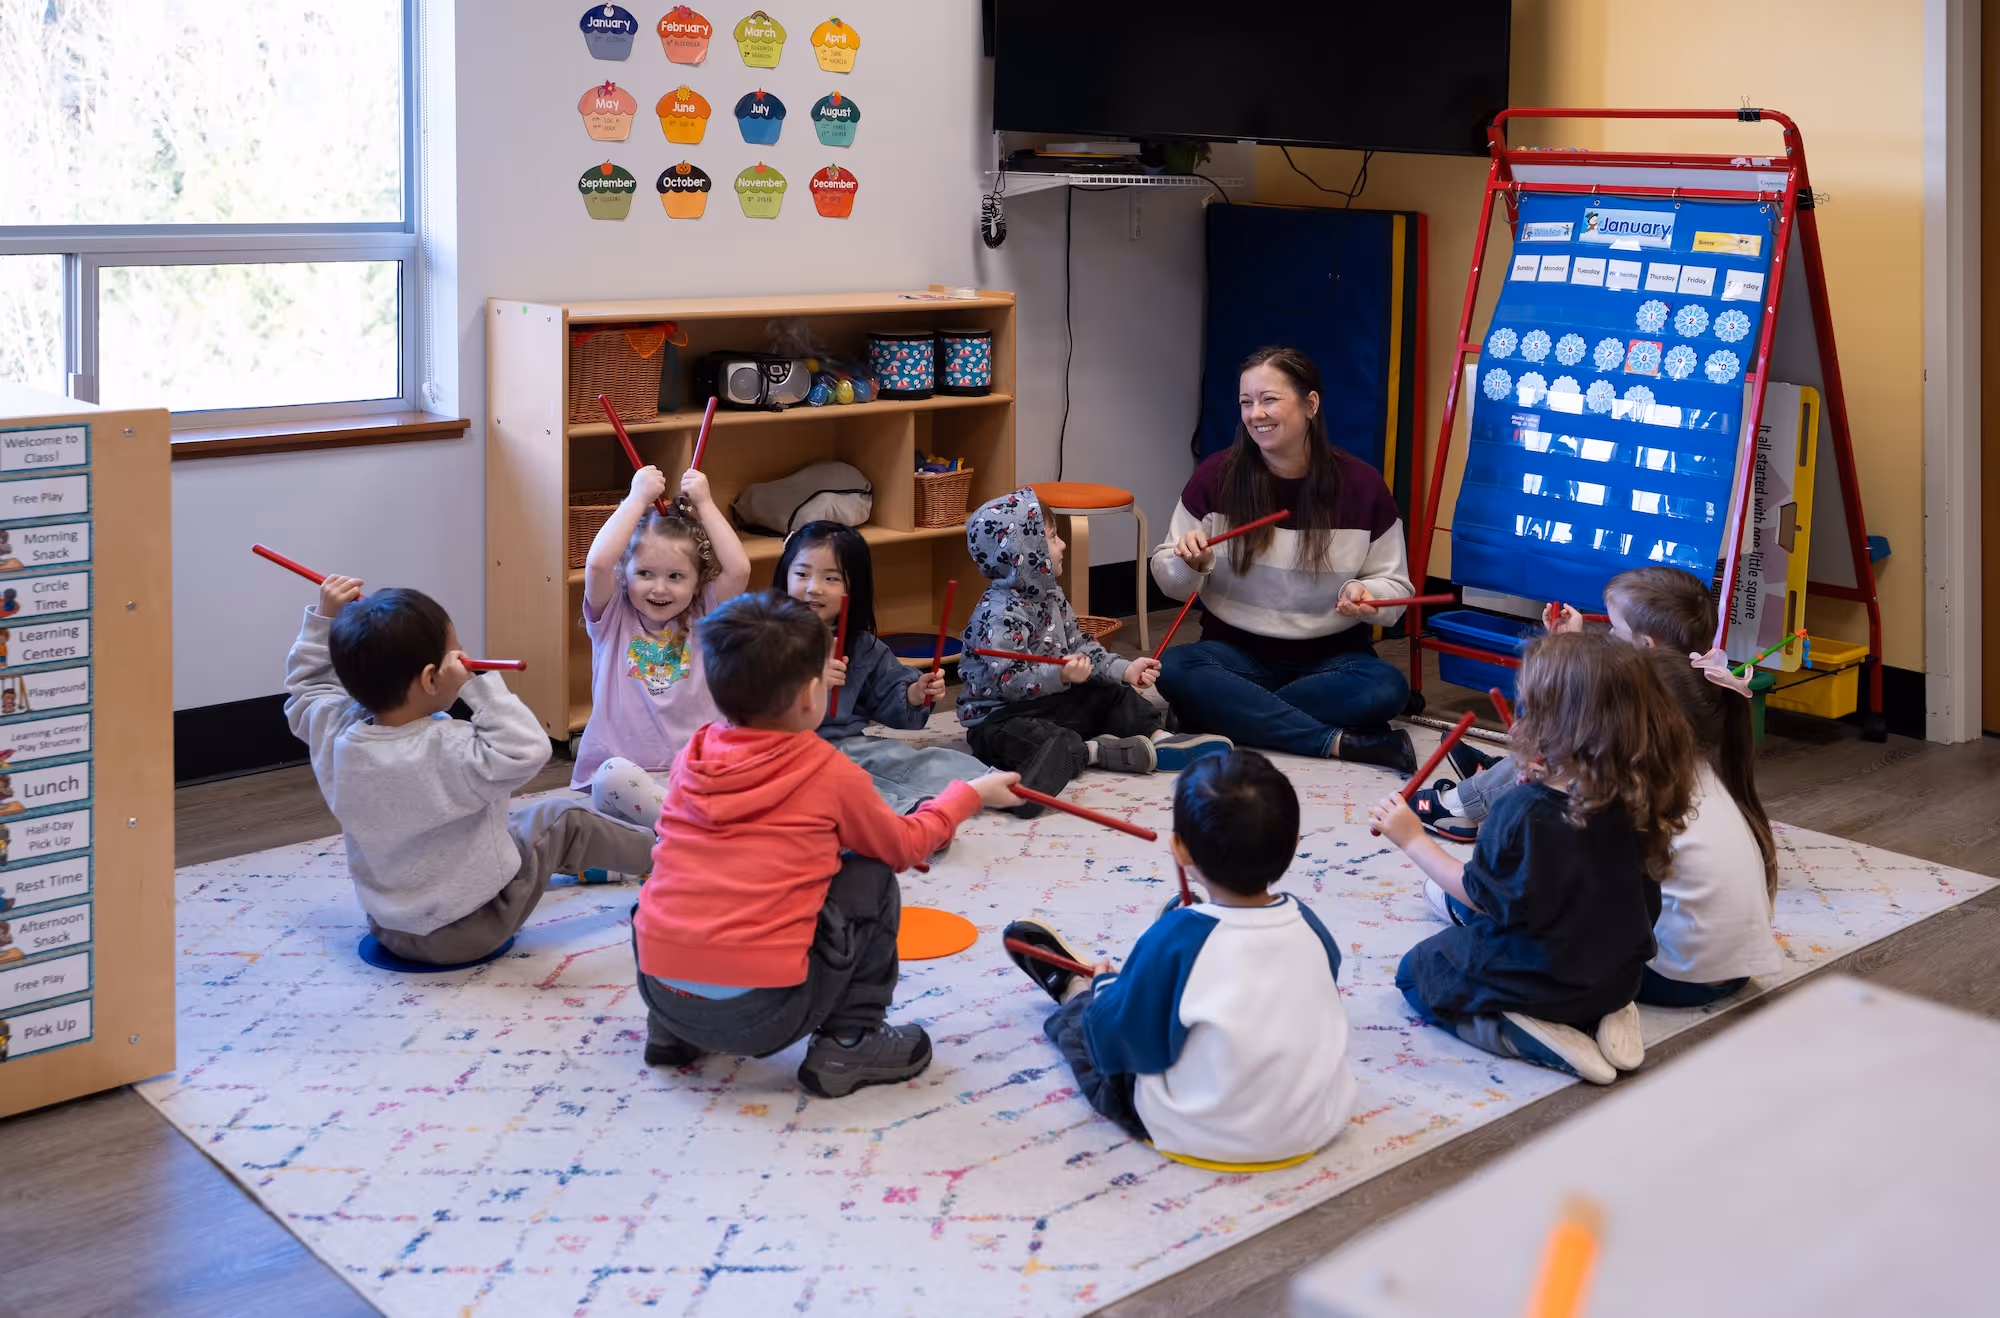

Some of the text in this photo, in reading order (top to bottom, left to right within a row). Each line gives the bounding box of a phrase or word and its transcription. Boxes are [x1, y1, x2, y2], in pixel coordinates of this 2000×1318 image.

[588, 16, 630, 31] January
[662, 21, 708, 35] February
[744, 26, 776, 38] March
[825, 32, 846, 44] April
[595, 98, 619, 111] May
[672, 102, 696, 112] June
[750, 104, 770, 115] July
[820, 106, 851, 118] August
[580, 178, 635, 189] September
[663, 177, 705, 187] October
[738, 178, 784, 188] November
[813, 179, 856, 188] December
[1600, 217, 1672, 241] January
[1687, 277, 1707, 285] Friday
[1728, 281, 1759, 291] Srday
[1759, 424, 1772, 433] It
[4, 434, 78, 448] Welcome to
[1758, 436, 1772, 450] all
[24, 452, 59, 464] Class!
[1755, 454, 1768, 495] started
[12, 492, 64, 504] Free Play
[1754, 498, 1767, 523] with
[24, 530, 78, 546] Morning
[33, 549, 69, 560] Snack
[1748, 552, 1764, 577] little
[32, 580, 69, 592] Circle
[35, 598, 67, 610] Time
[1744, 580, 1757, 620] square
[20, 626, 79, 642] Learning
[23, 644, 76, 660] Centers
[28, 682, 86, 698] Playground
[11, 722, 89, 742] Learning Center/
[18, 736, 82, 752] Play Structure
[24, 776, 80, 798] Lunch
[1418, 800, 1430, 811] N
[26, 820, 74, 836] Half-Day
[29, 836, 71, 850] Pick Up
[16, 872, 83, 893] Rest Time
[19, 912, 84, 934] Afternoon
[33, 931, 70, 948] Snack
[14, 974, 65, 992] Free Play
[24, 1018, 77, 1040] Pick Up
